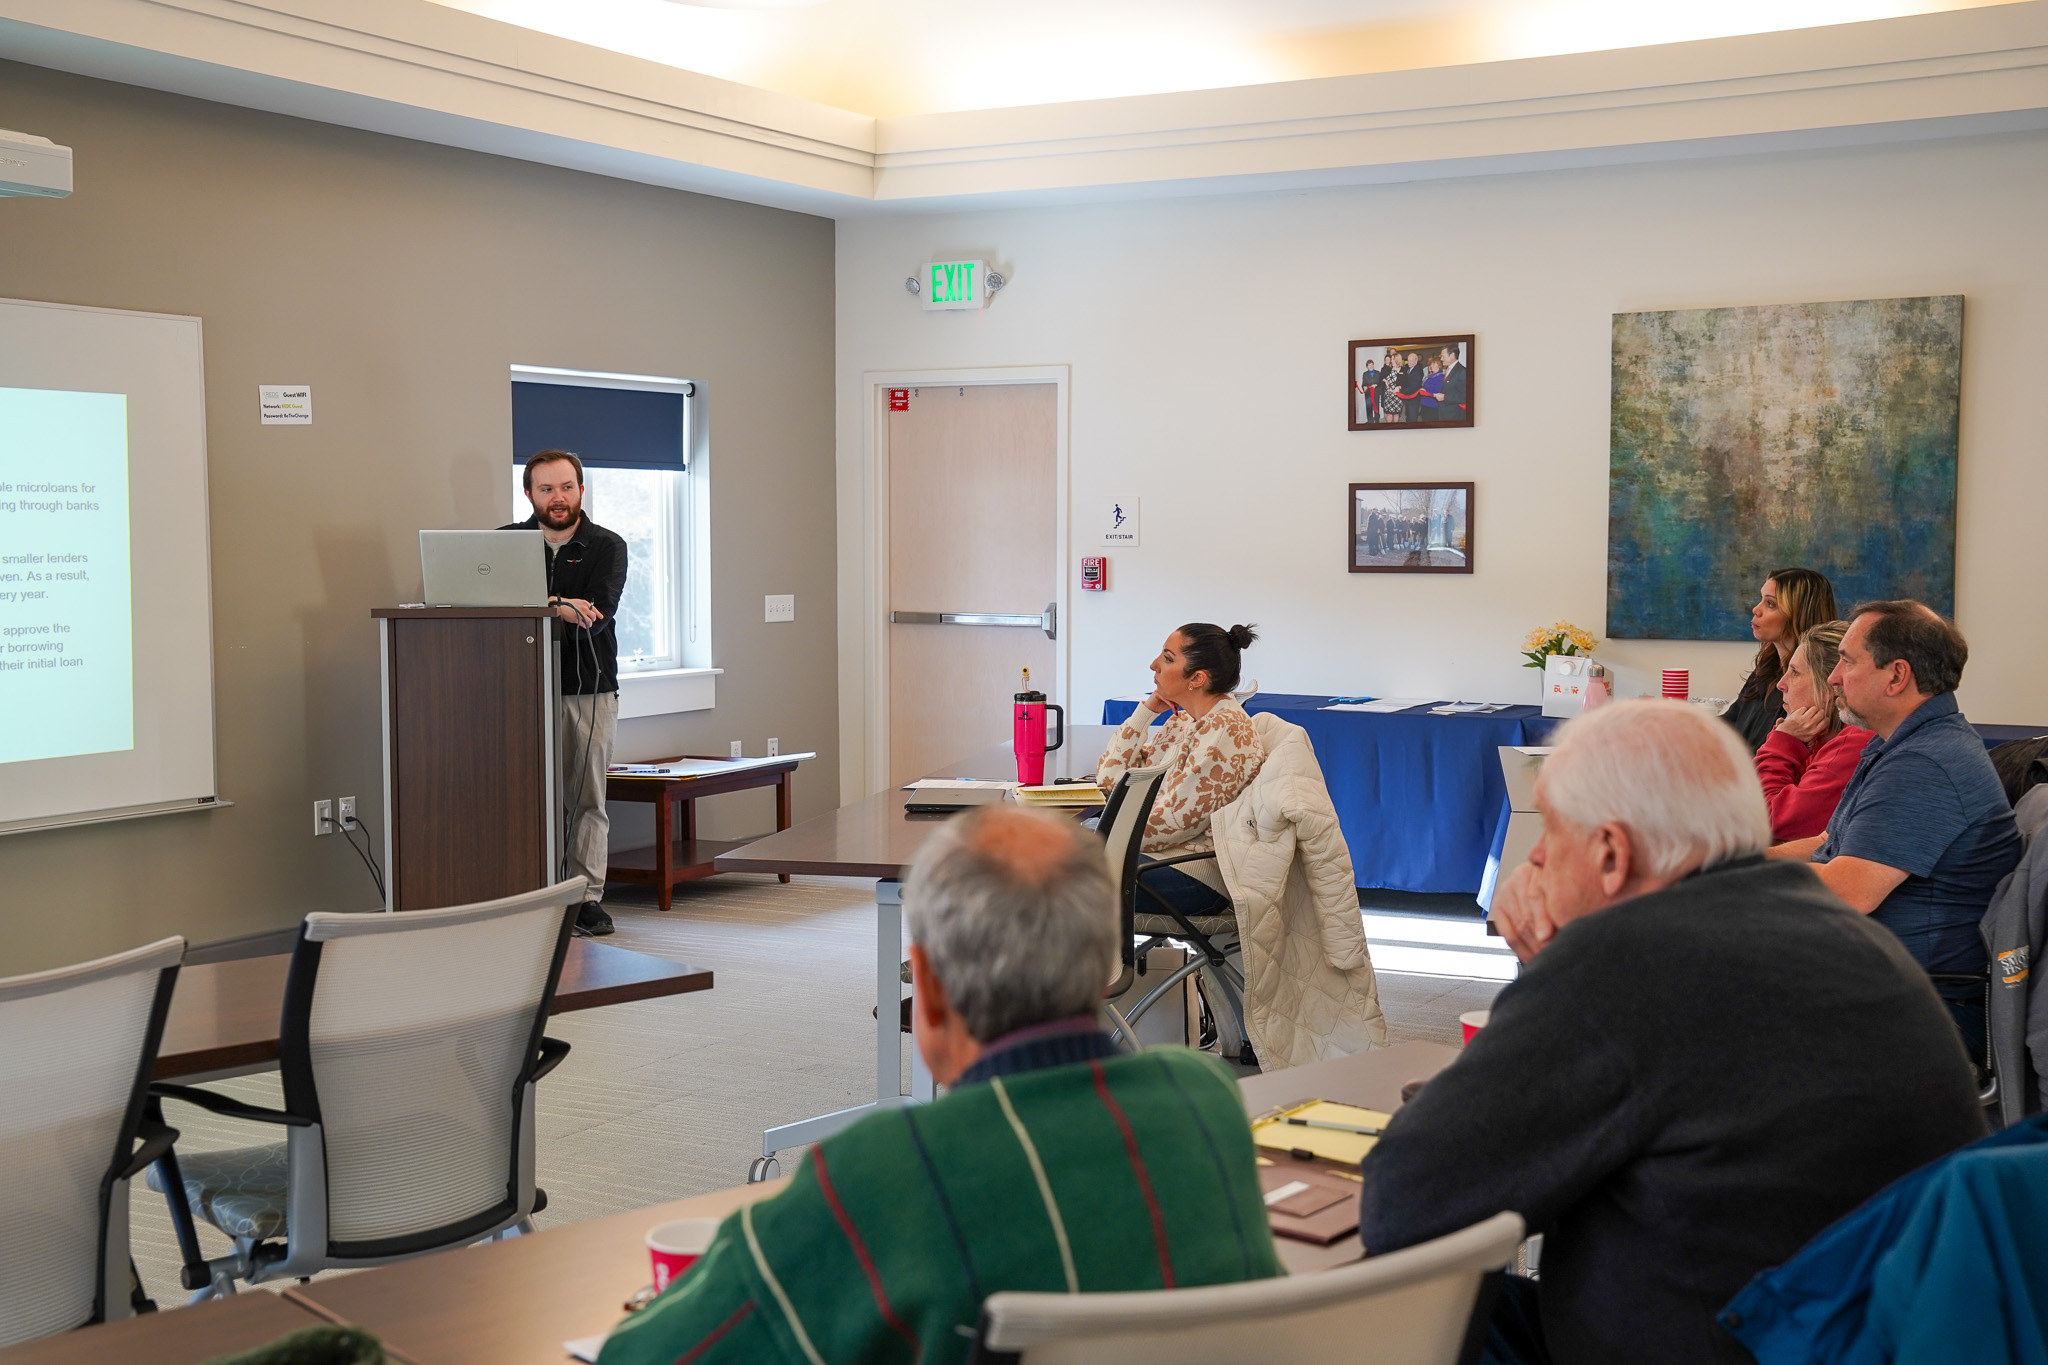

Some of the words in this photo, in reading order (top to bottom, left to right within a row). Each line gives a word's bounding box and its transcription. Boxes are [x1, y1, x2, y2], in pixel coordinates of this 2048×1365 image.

[0, 156, 28, 167] SONY
[931, 263, 975, 302] EXIT
[16, 481, 78, 493] microloans
[81, 482, 96, 493] for
[19, 499, 63, 513] through
[66, 500, 100, 511] banks
[2, 553, 44, 564] smaller
[47, 552, 89, 564] lenders
[26, 571, 42, 582] As
[45, 572, 53, 581] a
[55, 569, 90, 582] result,
[20, 589, 49, 602] year.
[3, 625, 50, 638] approve
[53, 622, 71, 633] the
[7, 640, 64, 654] borrowing
[27, 656, 57, 669] initial
[59, 656, 83, 667] loan
